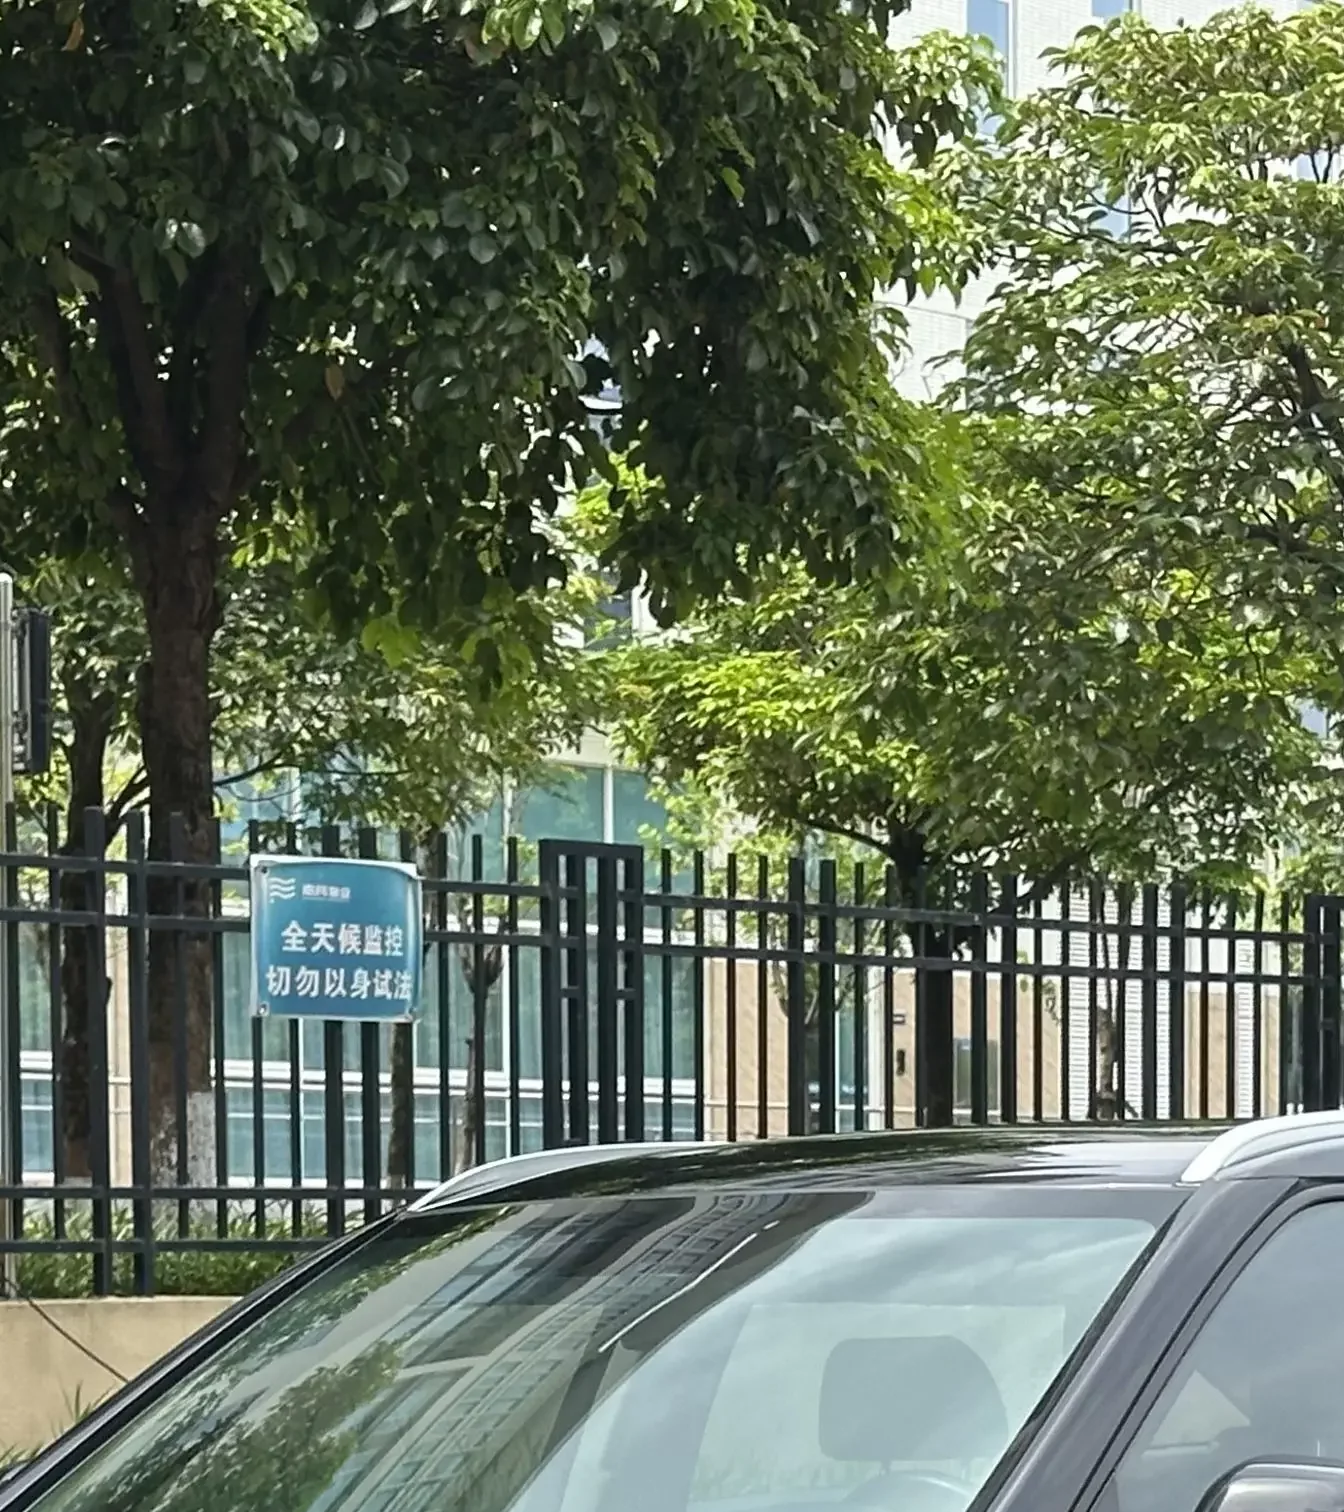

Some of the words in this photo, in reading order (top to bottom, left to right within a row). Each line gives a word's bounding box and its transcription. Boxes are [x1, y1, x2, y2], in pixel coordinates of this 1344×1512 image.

[281, 920, 404, 957] 全天候监控
[266, 965, 413, 1001] 切勿以身试法
